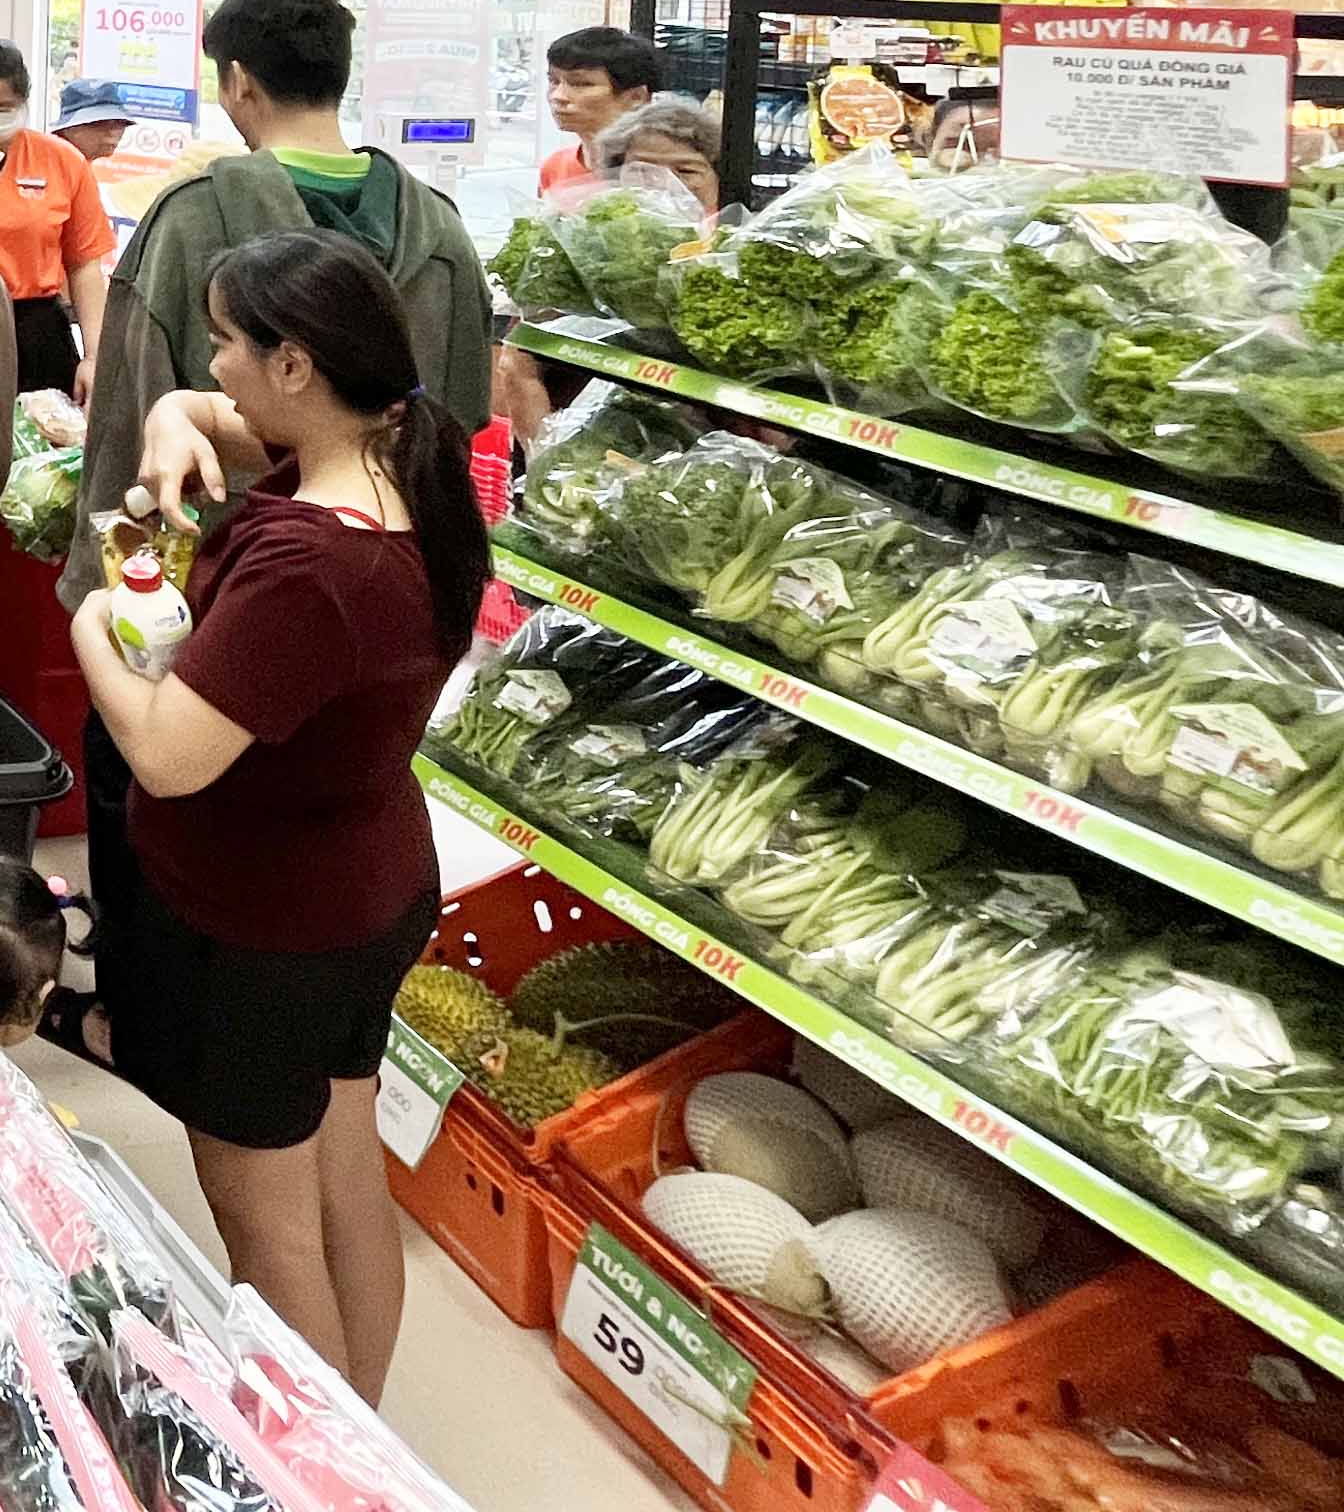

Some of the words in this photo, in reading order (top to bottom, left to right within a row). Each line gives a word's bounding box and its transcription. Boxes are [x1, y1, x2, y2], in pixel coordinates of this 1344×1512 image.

[96, 7, 185, 33] 106.000
[1034, 11, 1169, 43] KHUYẾN
[1179, 20, 1250, 48] MÃI
[1052, 56, 1086, 69] RAU
[634, 360, 678, 385] 10K
[848, 418, 901, 449] 10K
[558, 583, 601, 614] 10K
[758, 672, 810, 709] 10K
[1022, 790, 1089, 833] 10K
[499, 817, 542, 851] 10K
[693, 939, 747, 982] 10K
[953, 1100, 1017, 1152] 10K
[591, 1245, 645, 1302] TƯƠI
[593, 1312, 645, 1376] 59
